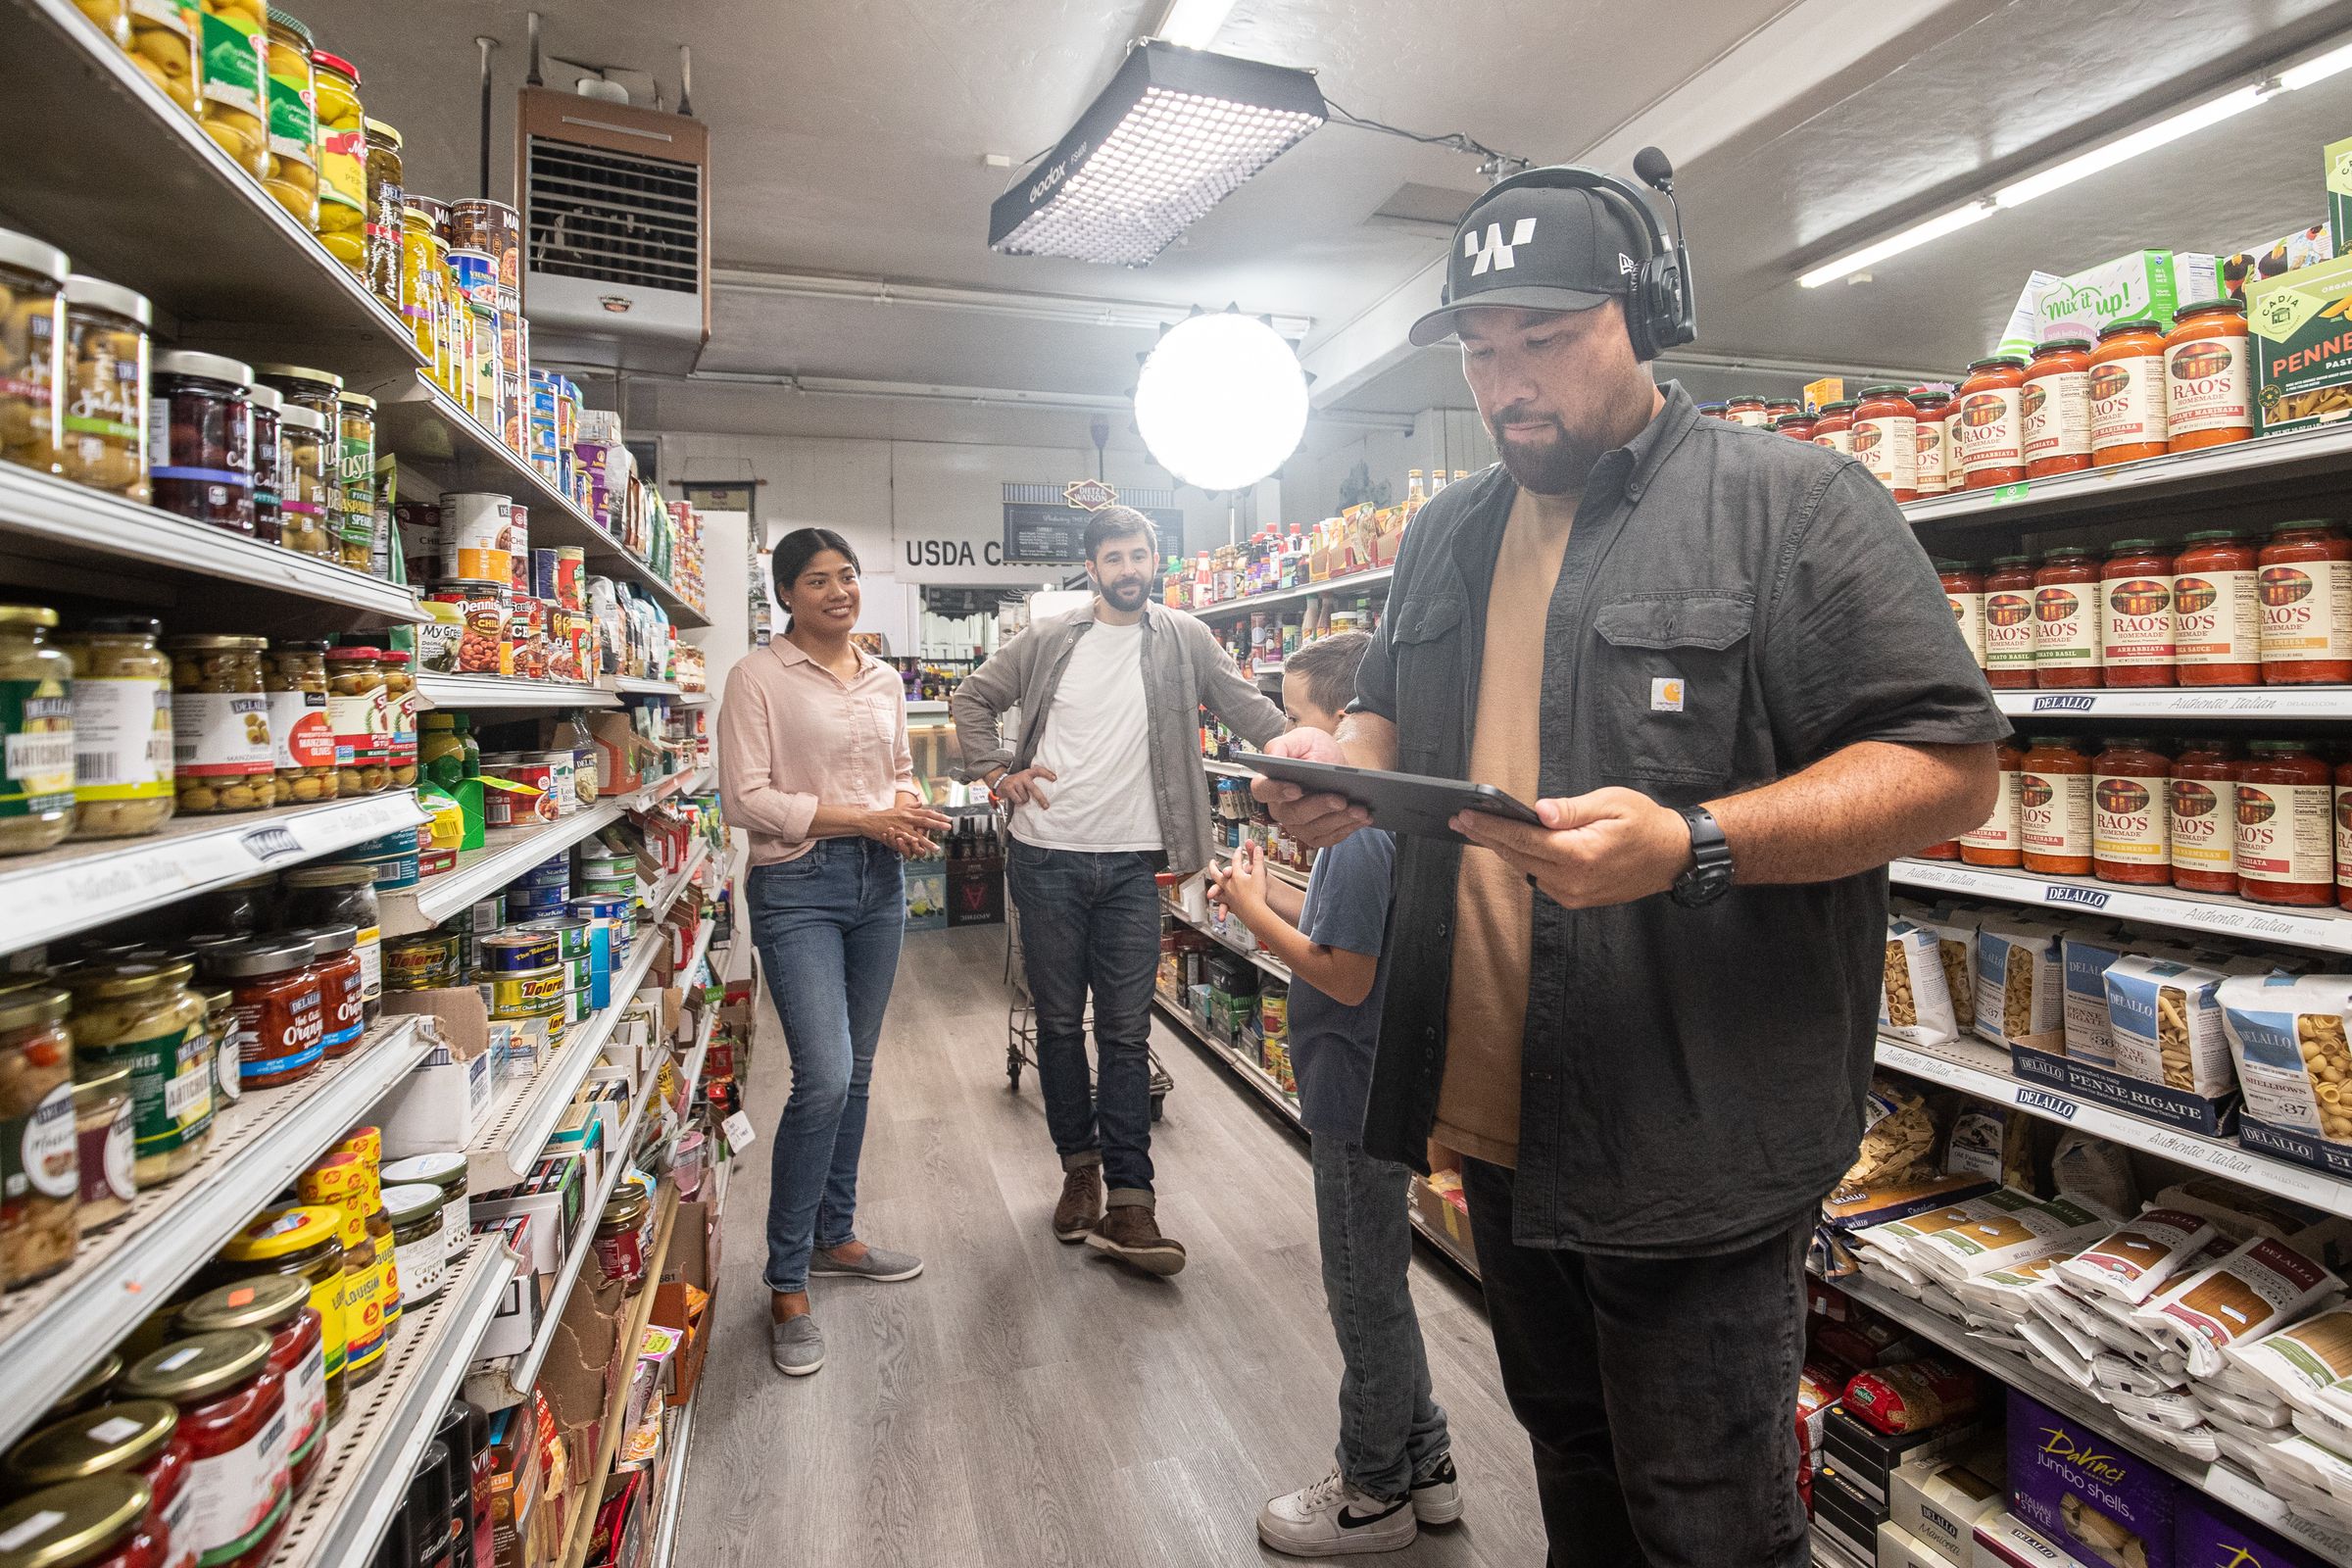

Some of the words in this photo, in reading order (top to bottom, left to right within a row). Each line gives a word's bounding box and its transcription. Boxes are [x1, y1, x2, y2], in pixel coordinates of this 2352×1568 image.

[1029, 160, 1066, 204] Godox
[2046, 299, 2078, 320] Mix
[2081, 292, 2093, 310] it
[2095, 281, 2132, 318] up!
[2262, 295, 2300, 318] CADIA
[2272, 331, 2352, 378] PENNE
[2173, 377, 2231, 401] RAO'S
[2194, 406, 2239, 417] MARINARA
[1963, 424, 2007, 445] RAO'S
[1074, 493, 1107, 503] WATSON
[906, 540, 976, 566] USDA
[421, 624, 443, 639] My
[477, 618, 499, 628] CHIL
[1987, 626, 2031, 642] RAO'S
[2112, 616, 2170, 633] RAO'S
[2034, 697, 2093, 711] DELALLO
[2168, 695, 2229, 710] Authentic
[2229, 695, 2278, 710] Italian
[2097, 813, 2148, 831] RAO'S
[2100, 829, 2142, 838] HOMEMADE
[2237, 827, 2274, 844] AO'S
[1905, 867, 1944, 885] Authentic
[2048, 887, 2107, 907] DELALLO
[536, 909, 564, 918] StarKist
[2182, 907, 2245, 927] Authentic
[2245, 915, 2294, 934] Italian
[388, 949, 447, 969] Dolores
[2109, 992, 2153, 1018] DELALLO
[282, 1020, 324, 1047] Orang
[2237, 1030, 2292, 1050] DELALLO
[1884, 1049, 1923, 1068] Authentic
[2021, 1057, 2063, 1080] DELALLO
[2068, 1071, 2129, 1099] PENNE
[2130, 1091, 2202, 1121] RIGATE
[2244, 1075, 2308, 1096] SHELLBOWS
[2019, 1090, 2075, 1117] DELALLO
[2146, 1131, 2205, 1159] Authentic
[2204, 1149, 2252, 1174] Italian
[2243, 1127, 2311, 1157] DELALLO
[2038, 1426, 2127, 1483] DaVinci
[2036, 1447, 2085, 1490] jumbo
[2086, 1483, 2131, 1519] shells
[1922, 1505, 1958, 1538] DELALLO
[2020, 1499, 2052, 1528] STYLE
[2013, 1530, 2055, 1559] DELALLO
